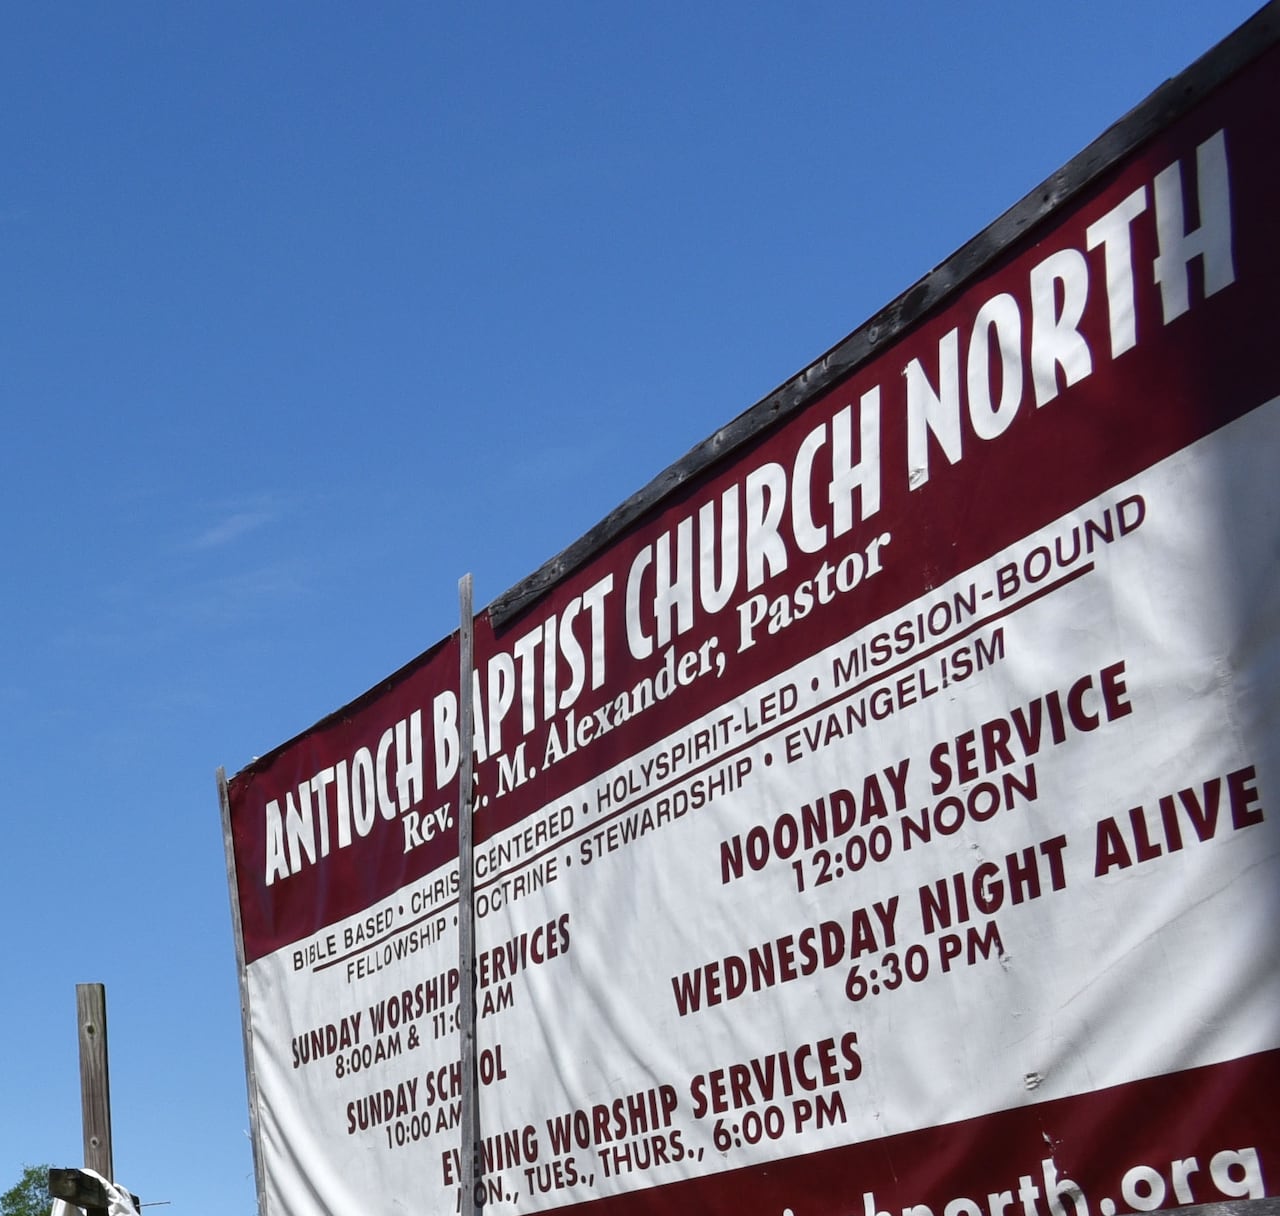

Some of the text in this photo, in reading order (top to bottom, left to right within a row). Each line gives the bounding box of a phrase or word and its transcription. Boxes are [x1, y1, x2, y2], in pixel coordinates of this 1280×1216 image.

[264, 128, 1236, 887] ANTIOCH BAPTIST CHURCH NORTH
[293, 494, 1146, 971] BIBLE BASED CHRISCENTERED HOLYSPIRIT-LED MISSION-BOUND
[402, 802, 454, 854] Rev.
[496, 741, 537, 798] M.
[541, 636, 726, 771] Alexander,
[736, 532, 891, 654] Pastor
[347, 627, 1005, 984] FELLOWSHIP OCTRINE STEWARDSHIP EVANGELISM
[720, 660, 1133, 885] NOONDAY SERVICE
[791, 762, 1038, 893] 12:00 NOON
[671, 765, 1264, 1017] WEDNESDAY NIGHT ALIVE
[845, 920, 1004, 1002] 6:30 PM
[291, 913, 570, 1069] SUNDAY WORSHIP ERVICES
[407, 1024, 420, 1050] &
[482, 981, 515, 1019] AM
[347, 1044, 507, 1134] SUNDAY SCHOL
[386, 1100, 462, 1149] 10:00 AM
[456, 1090, 847, 1213] ON., TUES., THURS., 6:00 PM
[546, 1084, 678, 1156] WORSHIP
[691, 1031, 862, 1119] SERVICES
